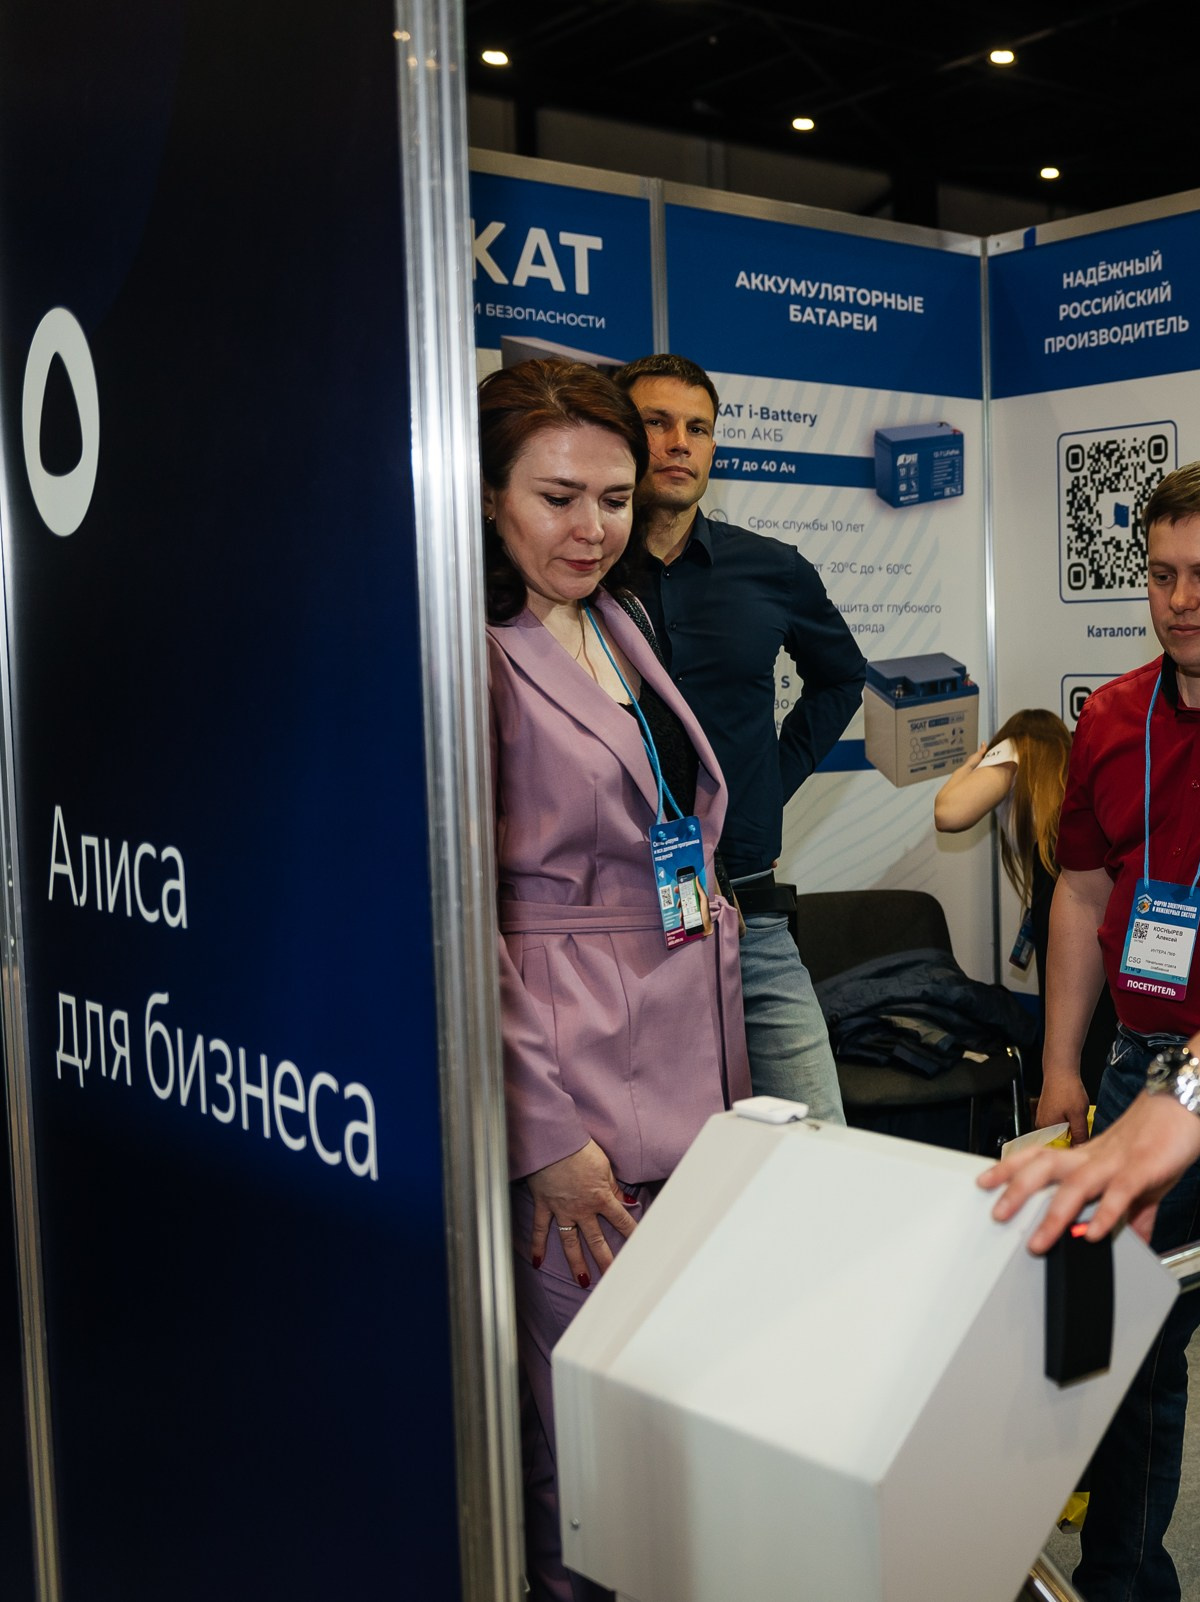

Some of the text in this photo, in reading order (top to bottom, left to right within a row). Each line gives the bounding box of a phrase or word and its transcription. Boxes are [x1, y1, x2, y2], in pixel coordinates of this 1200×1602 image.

[1063, 250, 1162, 289] НАДЁЖНЫЙ
[735, 271, 925, 314] АККУМУЛЯТОРНЫЕ
[1059, 281, 1172, 321] РОССИЙСКИЙ
[485, 303, 606, 329] БЕЗОПАСНОСТИ
[789, 304, 878, 332] БАТАРЕИ
[1044, 315, 1190, 354] ПРОИЗВОДИТЕЛЬ
[748, 404, 818, 427] i-Battery
[751, 427, 784, 442] АКБ
[714, 458, 796, 473] от 7 до 40 Ач
[747, 516, 865, 533] Срок службы 10 лет
[860, 563, 875, 575] до
[872, 603, 883, 613] от
[887, 601, 942, 617] глубокого
[1087, 624, 1147, 638] Каталоги
[48, 805, 188, 929] Алиса
[1127, 980, 1177, 997] ПОСЕТИТЕЛЬ
[56, 992, 379, 1182] для бизнеса
